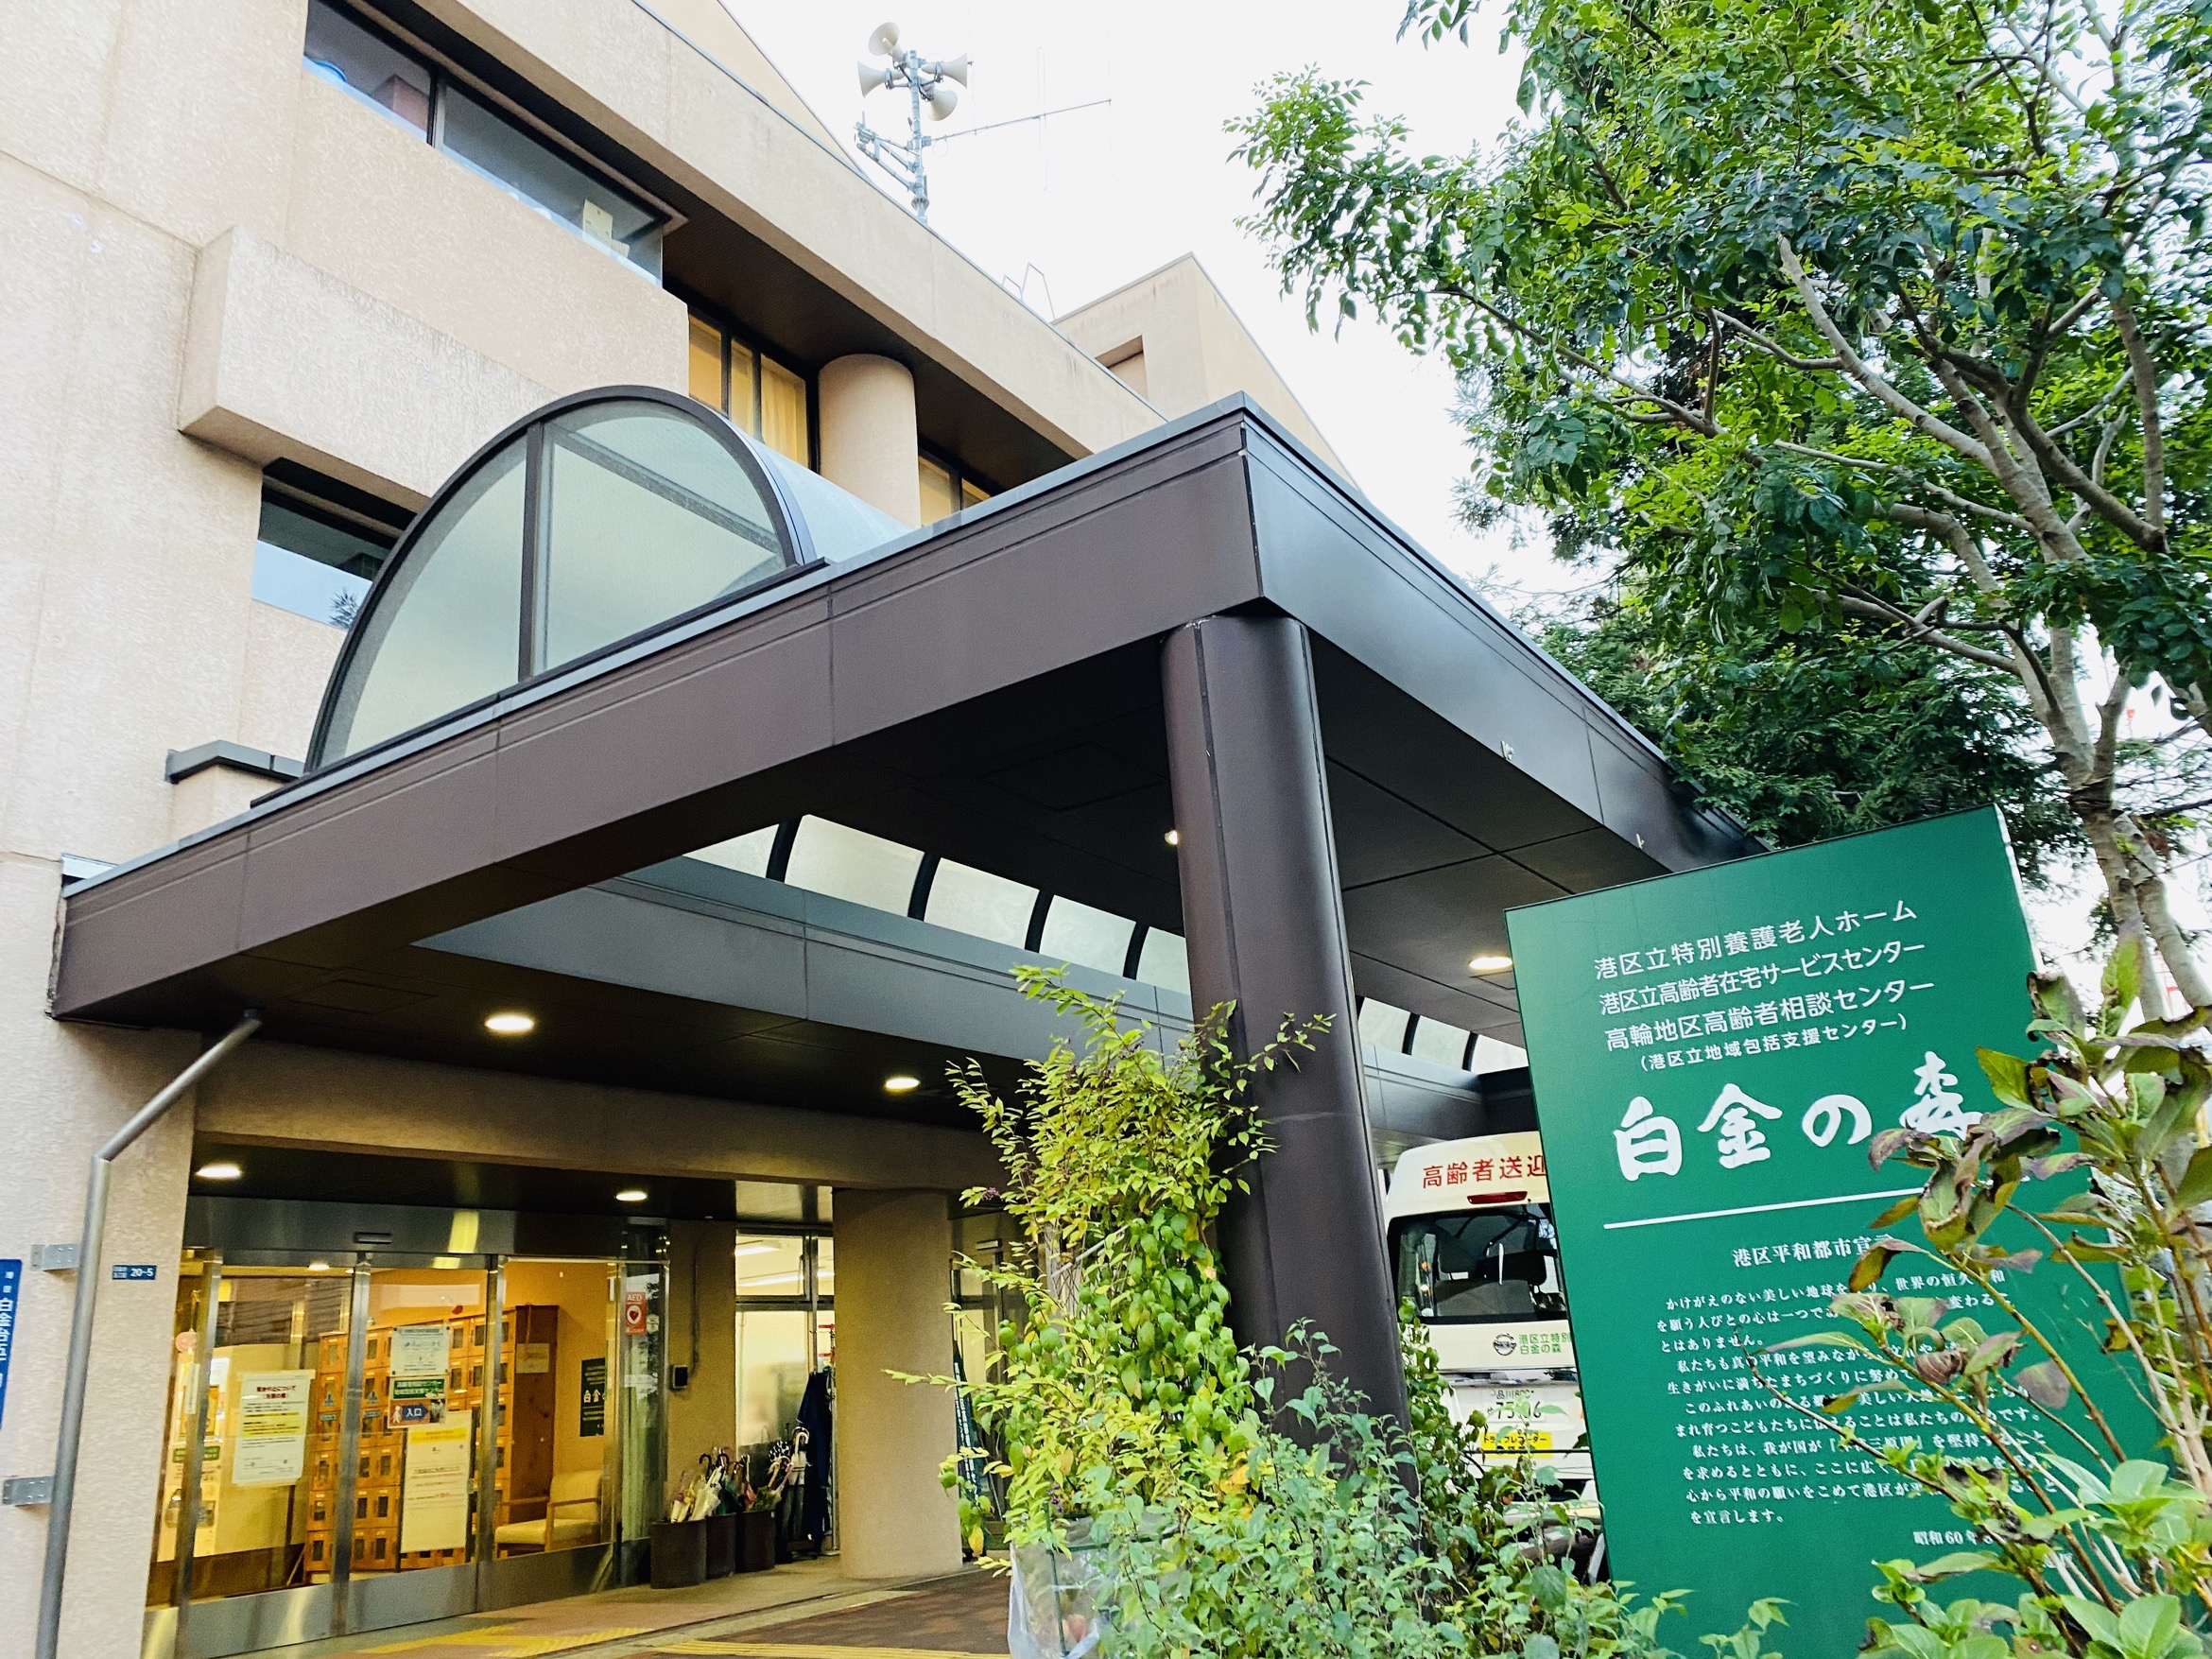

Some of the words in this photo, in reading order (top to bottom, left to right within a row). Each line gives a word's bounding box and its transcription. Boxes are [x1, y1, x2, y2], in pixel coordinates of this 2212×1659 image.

[1594, 900, 1918, 980] 港区立特別養護老人ホーム
[1599, 941, 1925, 1016] 港区立高齢者在宅サービスセンター
[1604, 979, 1935, 1052] 高輪地区高齢者相談センター
[1423, 1155, 1546, 1188] 高齢者送迎
[130, 1268, 154, 1277] 20-5
[406, 1408, 423, 1418] 入口
[1690, 1509, 1784, 1525] を宣言します。
